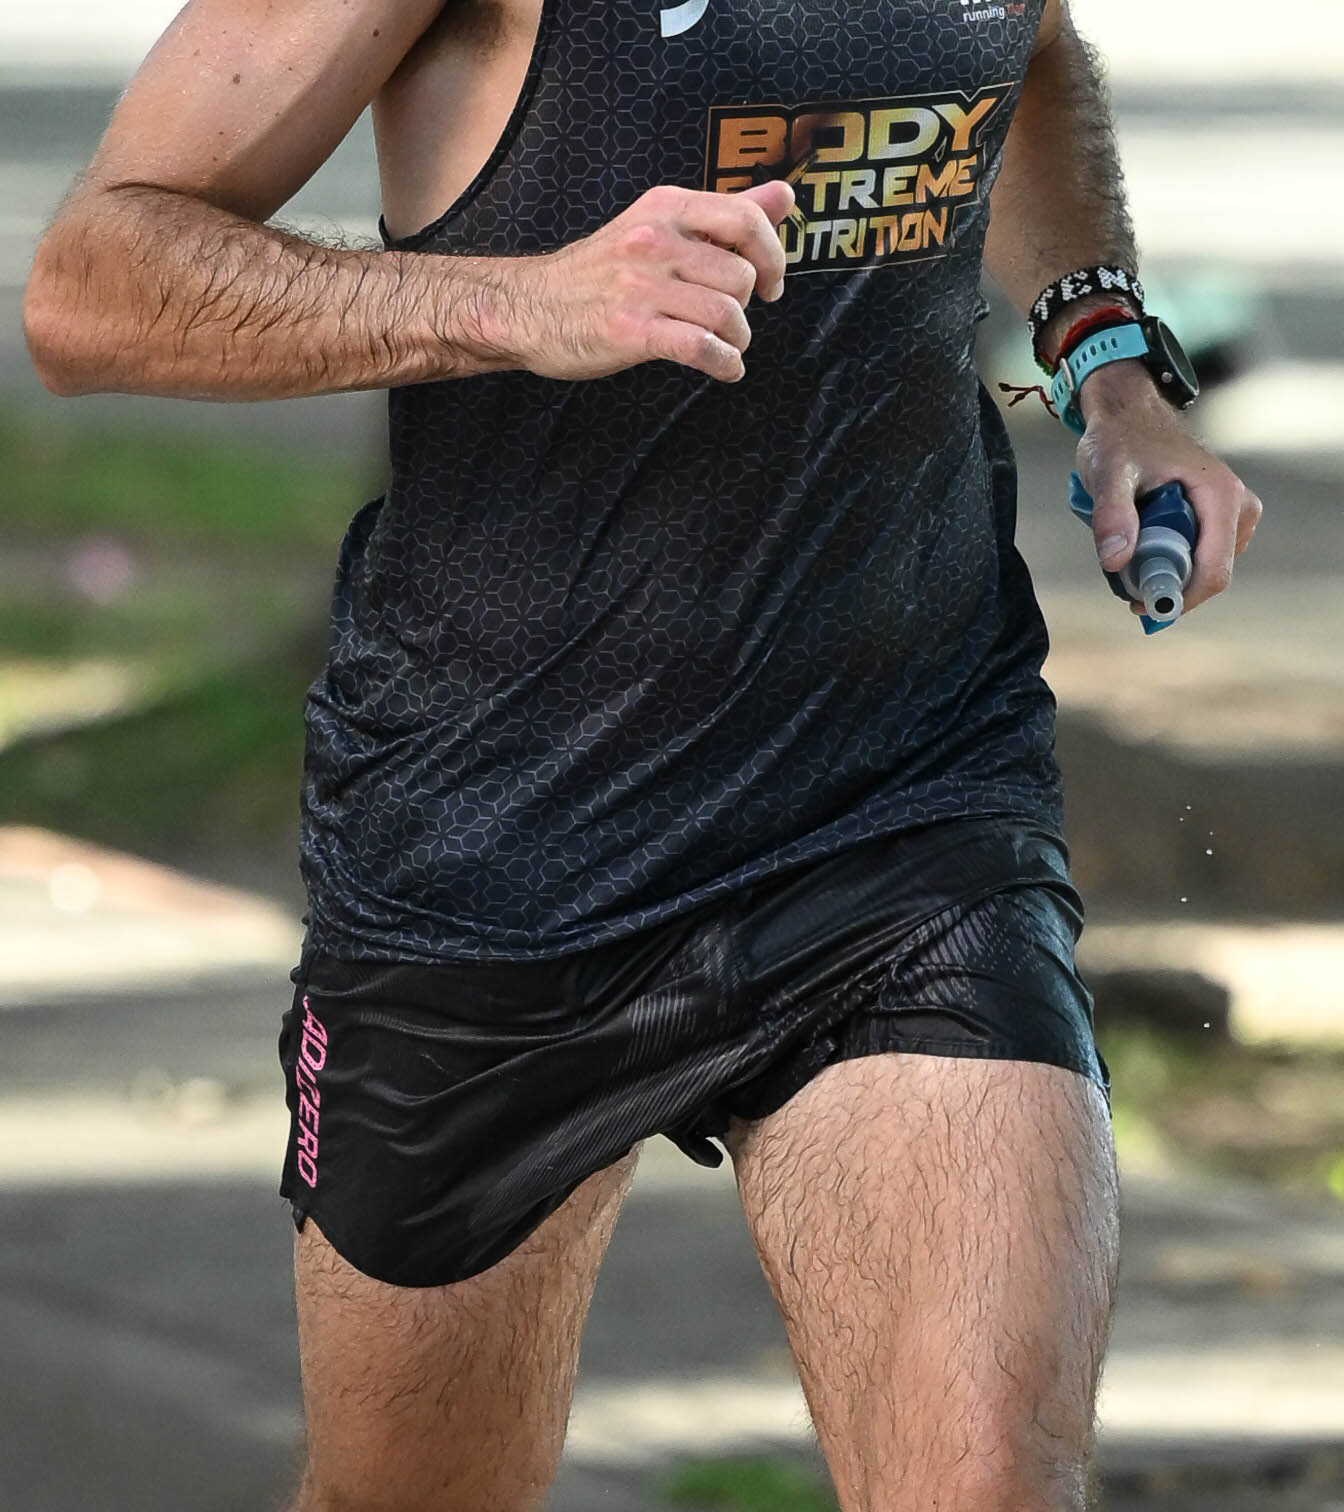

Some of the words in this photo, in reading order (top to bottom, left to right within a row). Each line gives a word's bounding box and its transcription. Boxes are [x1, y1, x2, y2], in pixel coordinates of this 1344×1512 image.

[962, 5, 1005, 22] running
[717, 97, 997, 169] BODY
[780, 206, 949, 265] UTRITION
[295, 995, 328, 1189] ADIZERO
